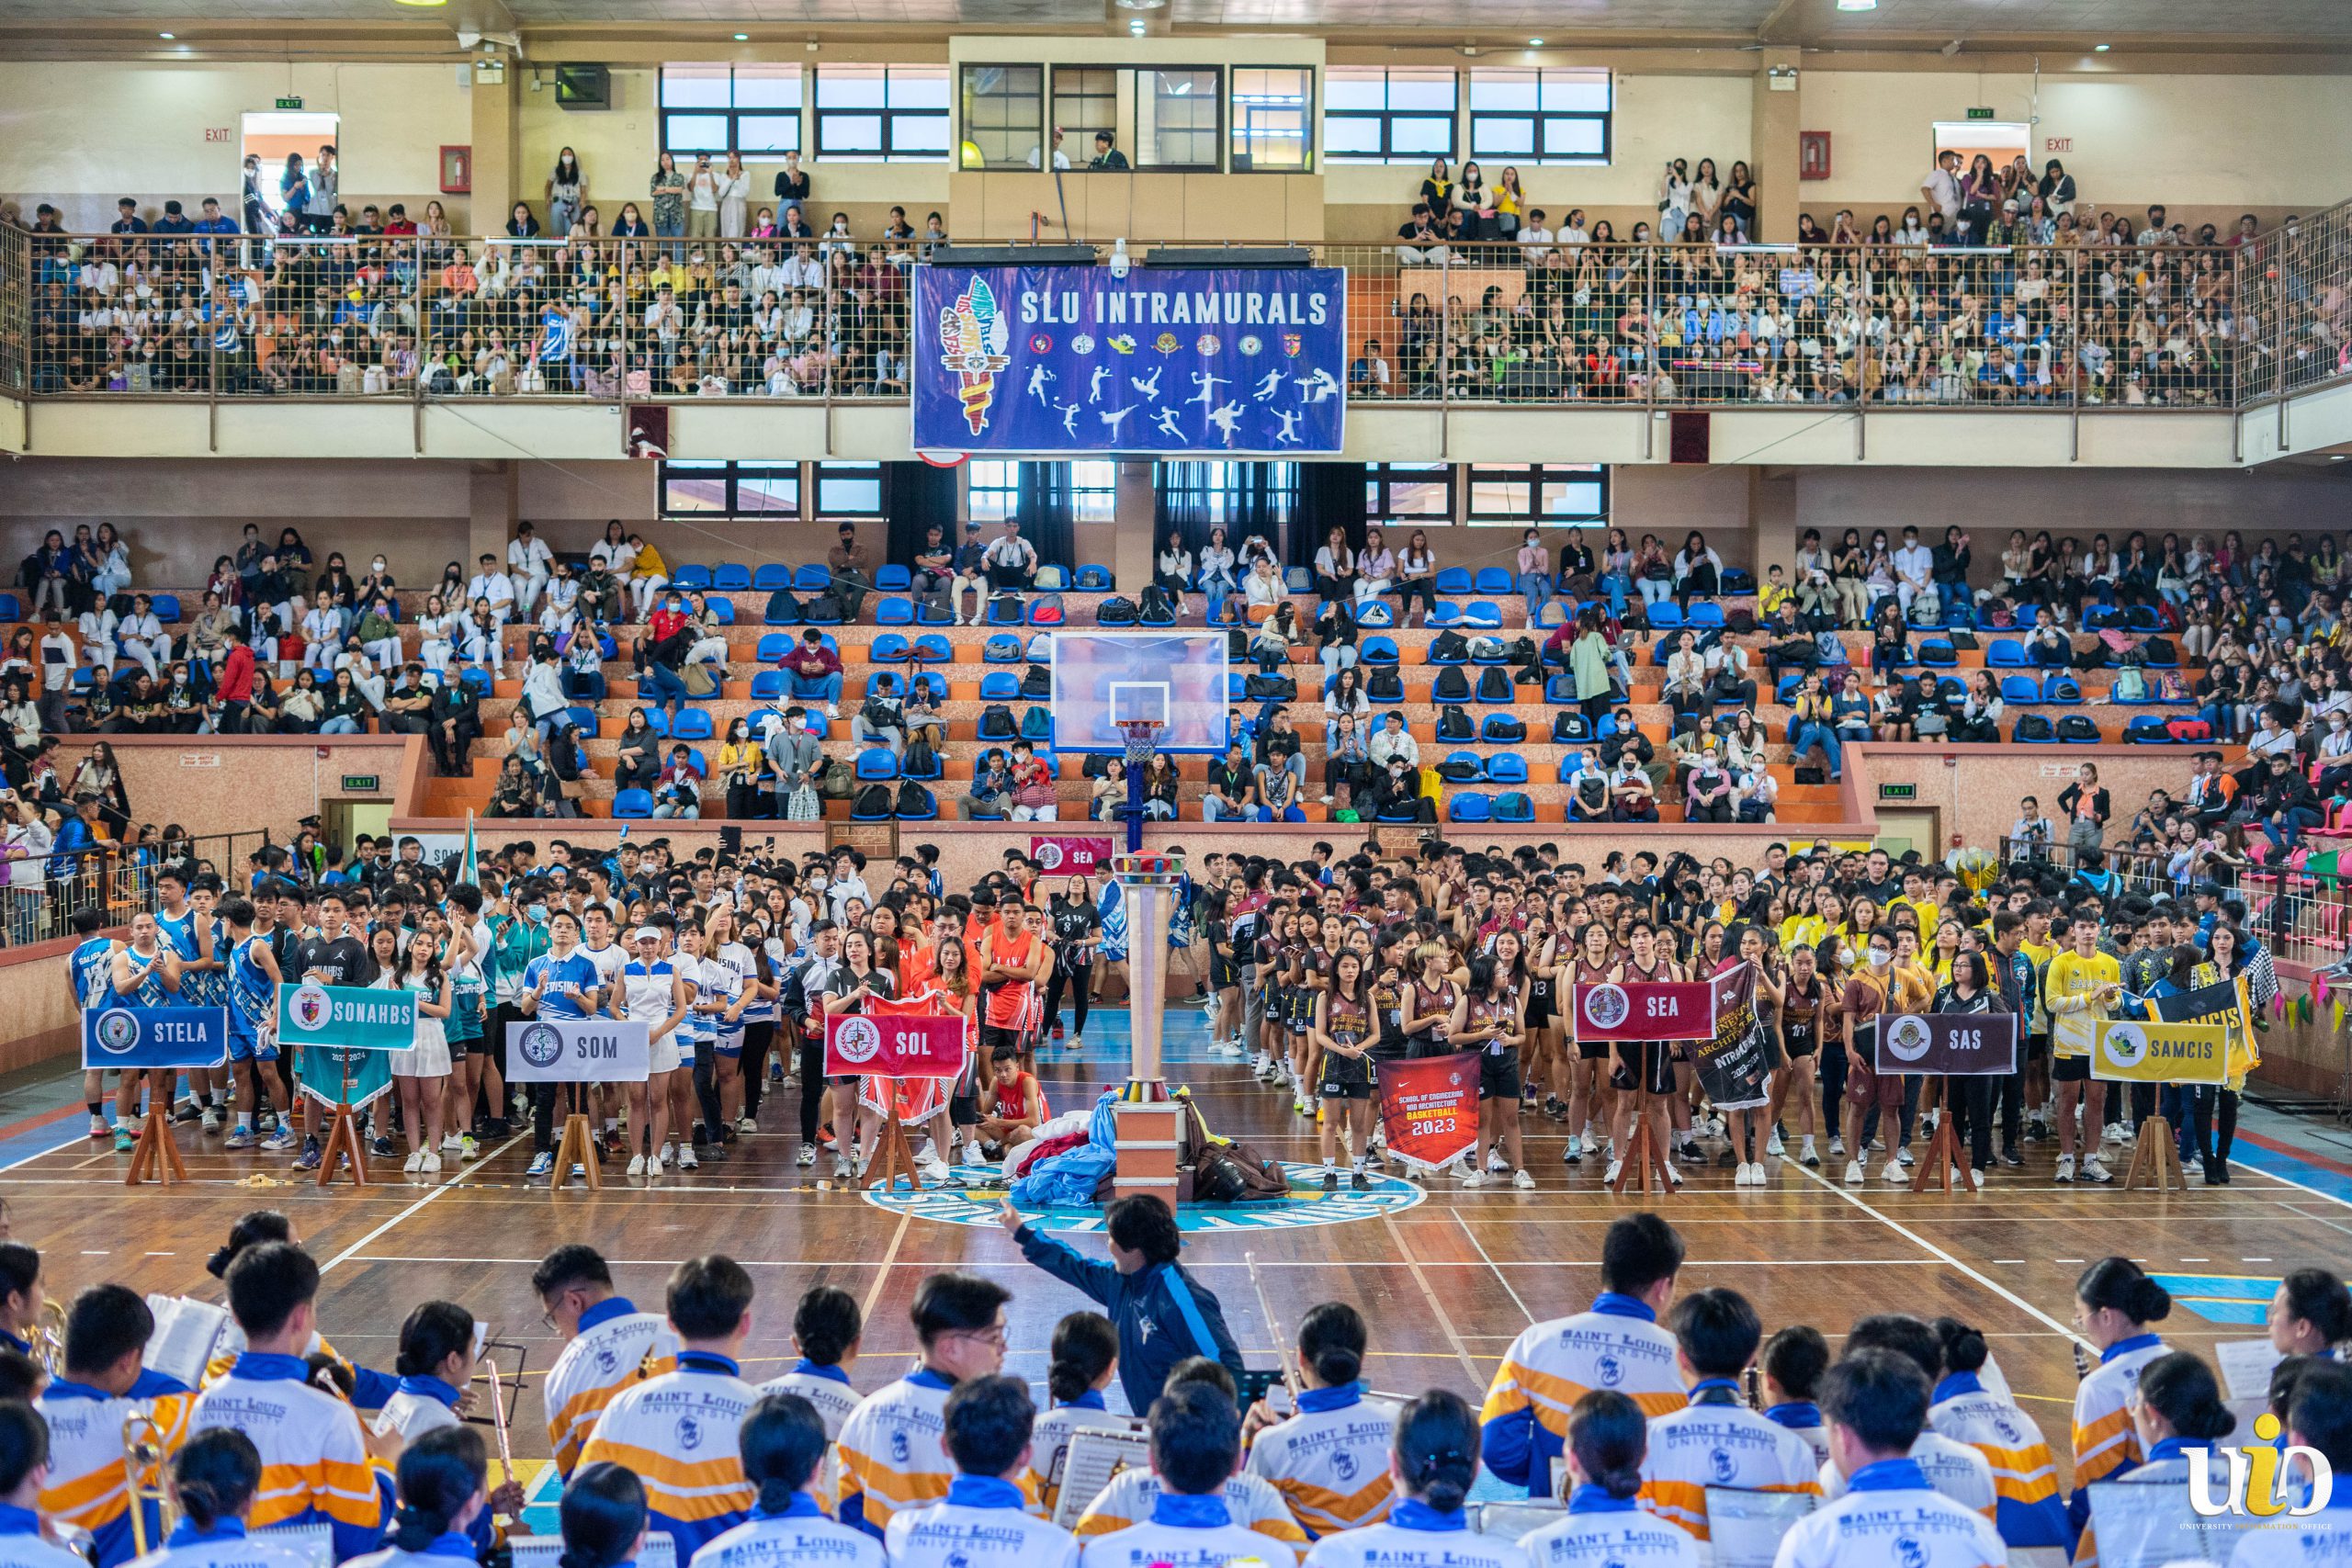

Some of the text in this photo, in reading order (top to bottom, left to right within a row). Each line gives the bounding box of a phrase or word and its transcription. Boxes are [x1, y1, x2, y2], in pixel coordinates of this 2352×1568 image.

[206, 129, 229, 141] EXIT
[2047, 139, 2071, 151] EXIT
[1022, 291, 1327, 325] SLU INTRAMURALS
[1073, 852, 1093, 863] SEA
[1064, 922, 1071, 931] 8
[1532, 981, 1547, 996] 13
[334, 1001, 411, 1025] SONAHBS
[1646, 996, 1679, 1017] SEA
[2179, 1007, 2241, 1029] MCIS
[154, 1022, 208, 1043] STELA
[1949, 1029, 1981, 1050] SAS
[577, 1036, 617, 1058] SOM
[896, 1032, 932, 1055] SOL
[2152, 1040, 2212, 1058] SAMCIS
[1398, 1095, 1420, 1104] SCHOOL
[1430, 1089, 1464, 1100] ENGINEERING
[1406, 1108, 1458, 1121] BASKETBALL
[1411, 1118, 1455, 1135] 2023
[1562, 1329, 1673, 1356] SAINT LOUIS
[247, 1396, 287, 1416] LOUIS
[643, 1392, 693, 1404] SAINT
[640, 1405, 738, 1422] UNIVERSIT
[911, 1405, 944, 1426] LOUI
[1035, 1422, 1069, 1431] AINT
[1667, 1422, 1777, 1442] SAINT LOUIS
[1288, 1427, 1337, 1450] SAINT
[1290, 1434, 1385, 1461] UNIVERSIT
[1667, 1436, 1777, 1453] UNIVERSITY
[1839, 1510, 1902, 1525] SAINT
[970, 1523, 1024, 1543] LOUIS
[1550, 1529, 1679, 1549] SAINT LOUIS
[794, 1534, 857, 1553] LOUIS
[1199, 1549, 1238, 1561] LOU
[1365, 1549, 1430, 1563] SAINT
